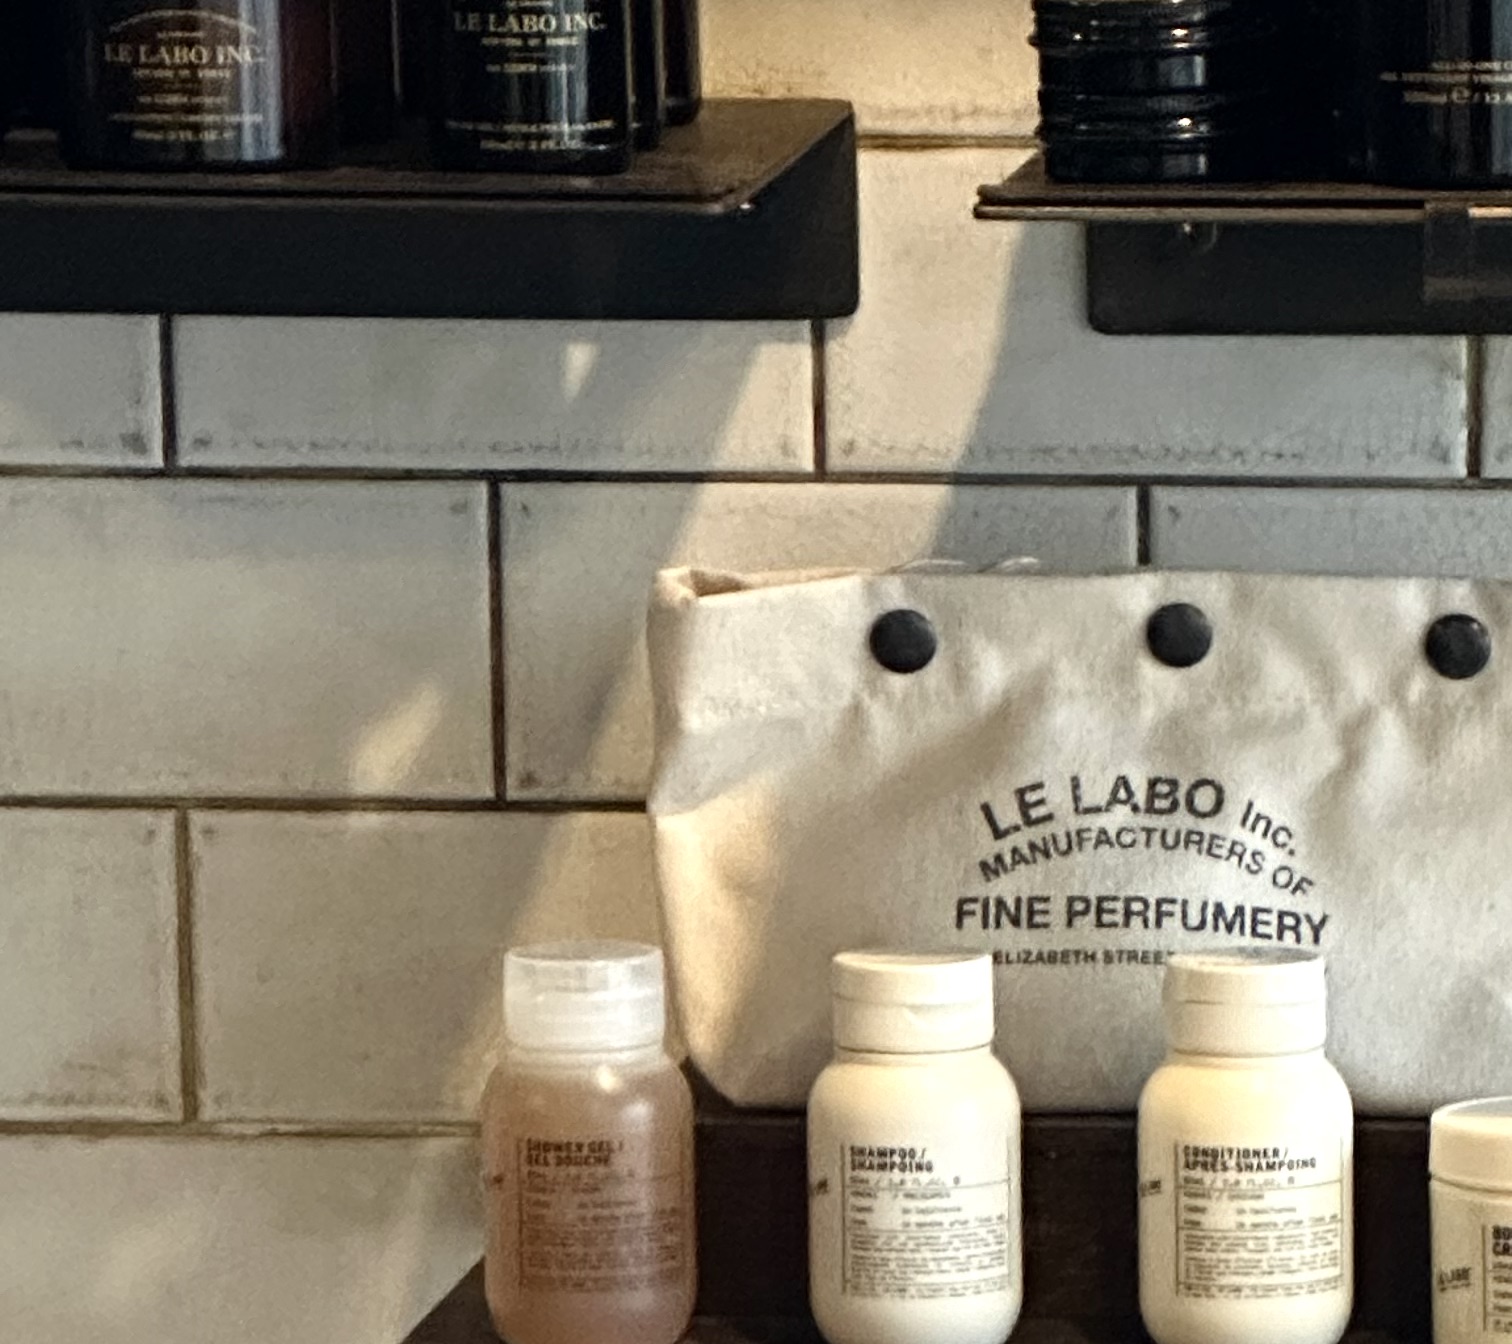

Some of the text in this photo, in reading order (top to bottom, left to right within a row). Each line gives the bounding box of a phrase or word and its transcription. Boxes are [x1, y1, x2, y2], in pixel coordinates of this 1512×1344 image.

[489, 12, 557, 33] LABO
[139, 44, 208, 66] LABO
[980, 774, 1297, 856] LE LABO Inc.
[978, 825, 1315, 897] MANUFACTURERS OF
[954, 895, 1330, 946] FINE PERFUMERY
[991, 948, 1174, 966] ELIZABETH STREE
